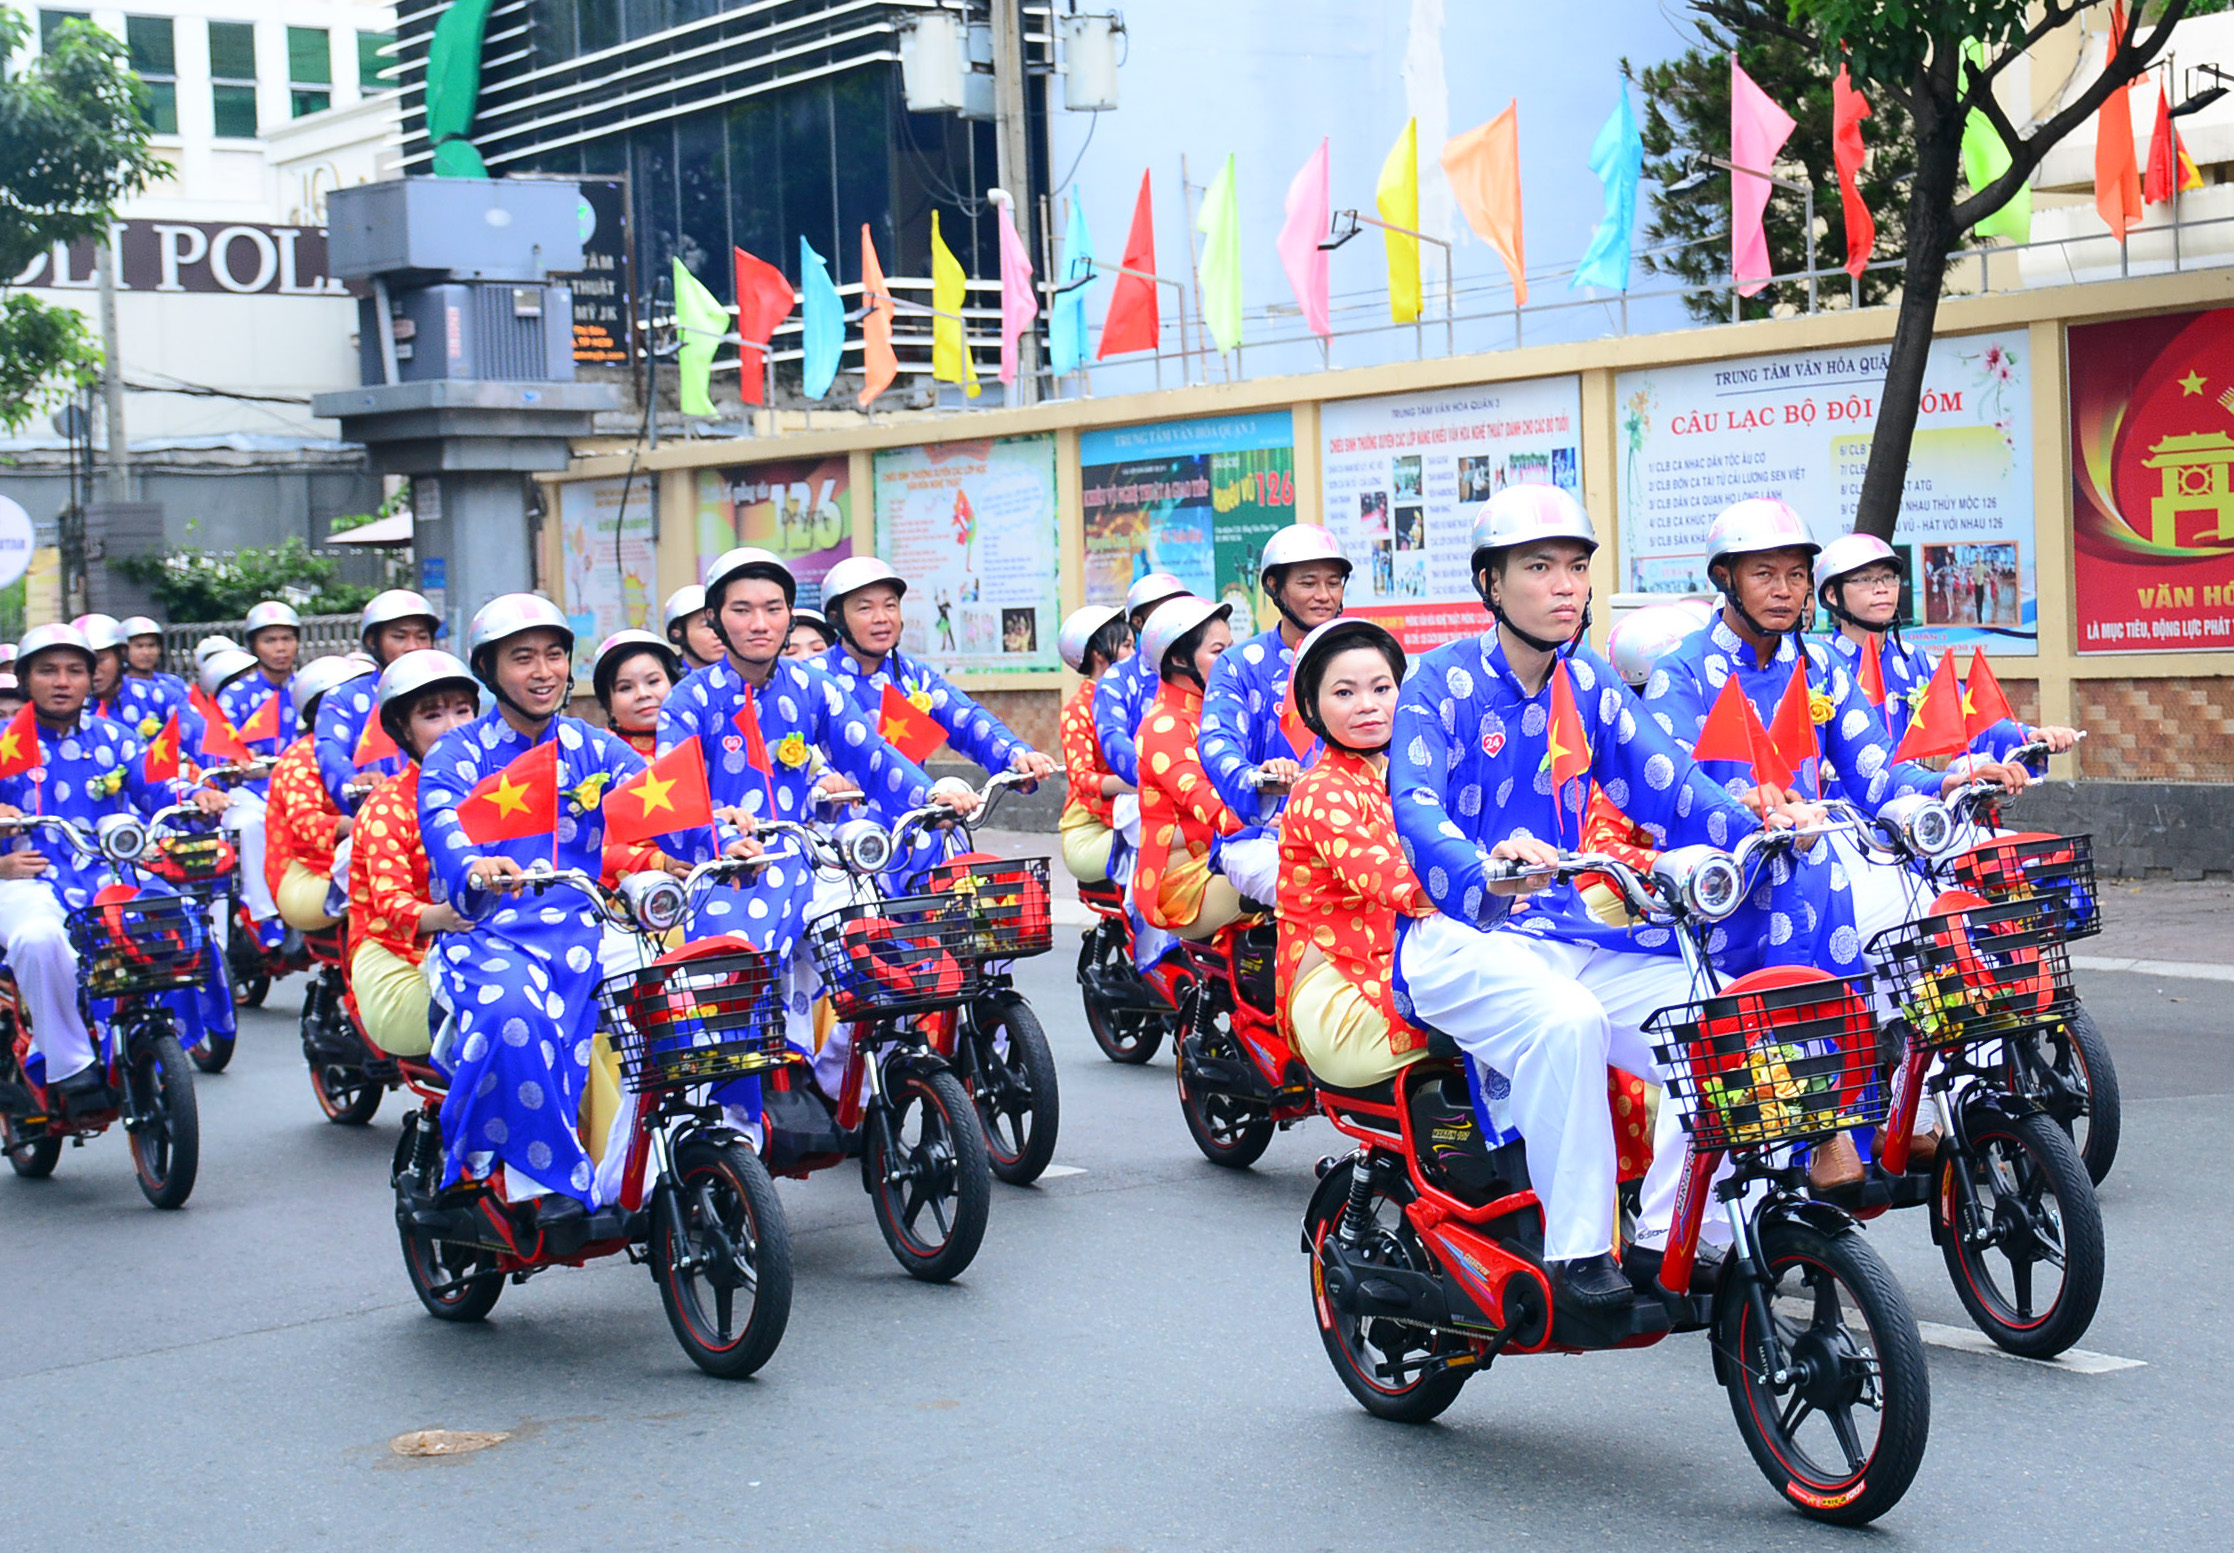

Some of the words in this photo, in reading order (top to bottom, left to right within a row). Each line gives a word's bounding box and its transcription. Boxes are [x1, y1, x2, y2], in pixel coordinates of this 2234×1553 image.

[152, 224, 350, 295] POL
[1715, 370, 1758, 386] TRUNG
[1763, 363, 1790, 381] TÂM
[1796, 358, 1822, 376] VĂN
[1827, 355, 1855, 374] HÓA
[1860, 354, 1889, 372] QUẬ
[1671, 409, 1719, 435] CÂU
[1727, 407, 1775, 432] LẠC
[1784, 398, 1817, 427] BỘ
[1827, 394, 1873, 424] ĐỘI
[1850, 443, 1866, 455] CLB
[1656, 461, 1671, 472] CLB
[1672, 459, 1683, 470] CA
[1850, 464, 1867, 475] CLB
[1256, 471, 1295, 507] 126
[1656, 479, 1672, 491] CLB
[1690, 476, 1701, 488] CA
[1770, 470, 1787, 482] SEN
[1789, 466, 1806, 481] VIỆT
[1914, 480, 1932, 491] ATG
[770, 477, 845, 552] 126
[1656, 498, 1671, 510] CLB
[1690, 495, 1701, 507] CA
[1702, 494, 1723, 507] QUAN
[1906, 499, 1930, 512] NHAU
[1959, 495, 1979, 511] MỘC
[1982, 497, 1997, 509] 126
[1657, 517, 1672, 528] CLB
[1673, 516, 1683, 527] CA
[1922, 517, 1940, 531] HÁT
[1960, 517, 1985, 530] NHAU
[1988, 517, 2003, 529] 126
[1657, 536, 1672, 547] CLB
[2137, 583, 2194, 609] VĂN
[2087, 620, 2100, 640] LÀ
[2101, 622, 2124, 642] MỤC
[2126, 618, 2151, 639] TIÊU,
[2152, 617, 2181, 641] ĐỘNG
[2182, 618, 2202, 640] LỰC
[2203, 615, 2231, 636] PHÁT
[1675, 1163, 1693, 1216] MARTIN
[1758, 1346, 1770, 1376] MARTIN
